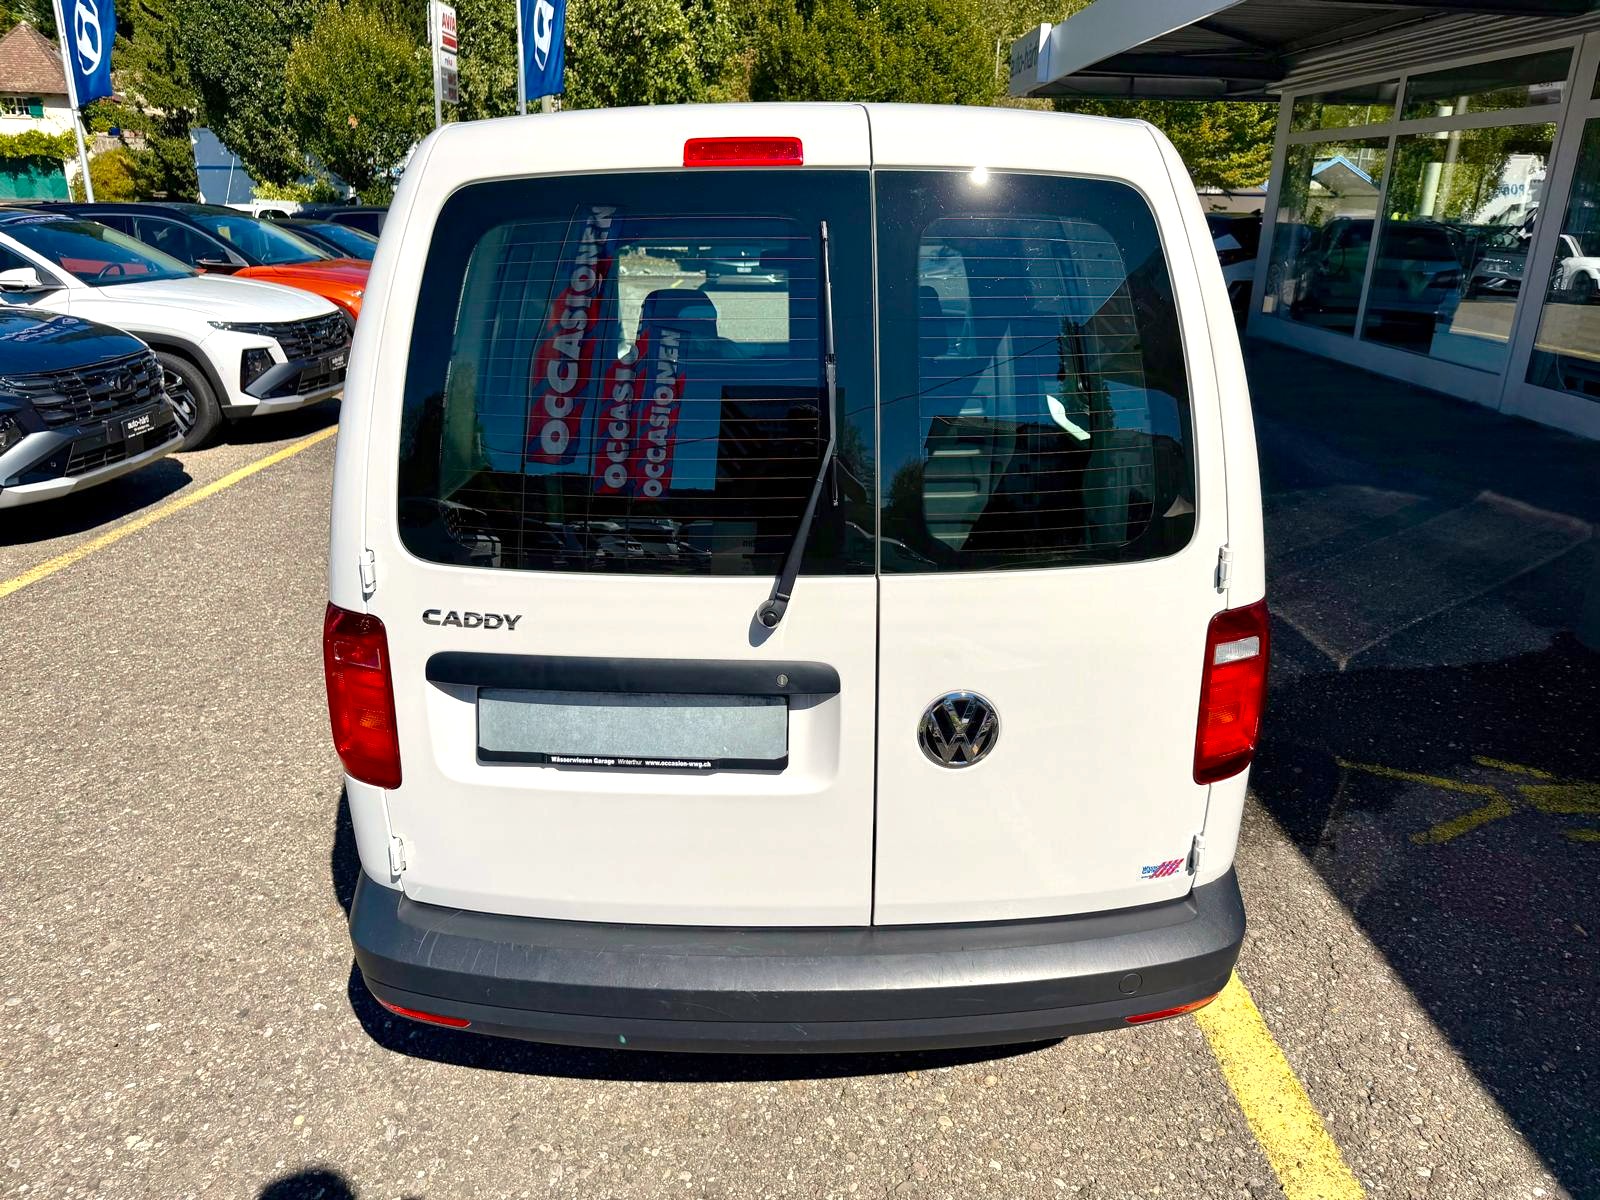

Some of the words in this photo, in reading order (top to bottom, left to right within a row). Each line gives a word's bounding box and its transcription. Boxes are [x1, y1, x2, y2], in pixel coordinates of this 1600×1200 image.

[540, 205, 617, 455] OCCASIONEN
[643, 329, 681, 497] OCCASIONEN
[422, 608, 523, 631] CADDY
[593, 757, 615, 766] Garage
[617, 758, 643, 766] Winterthur
